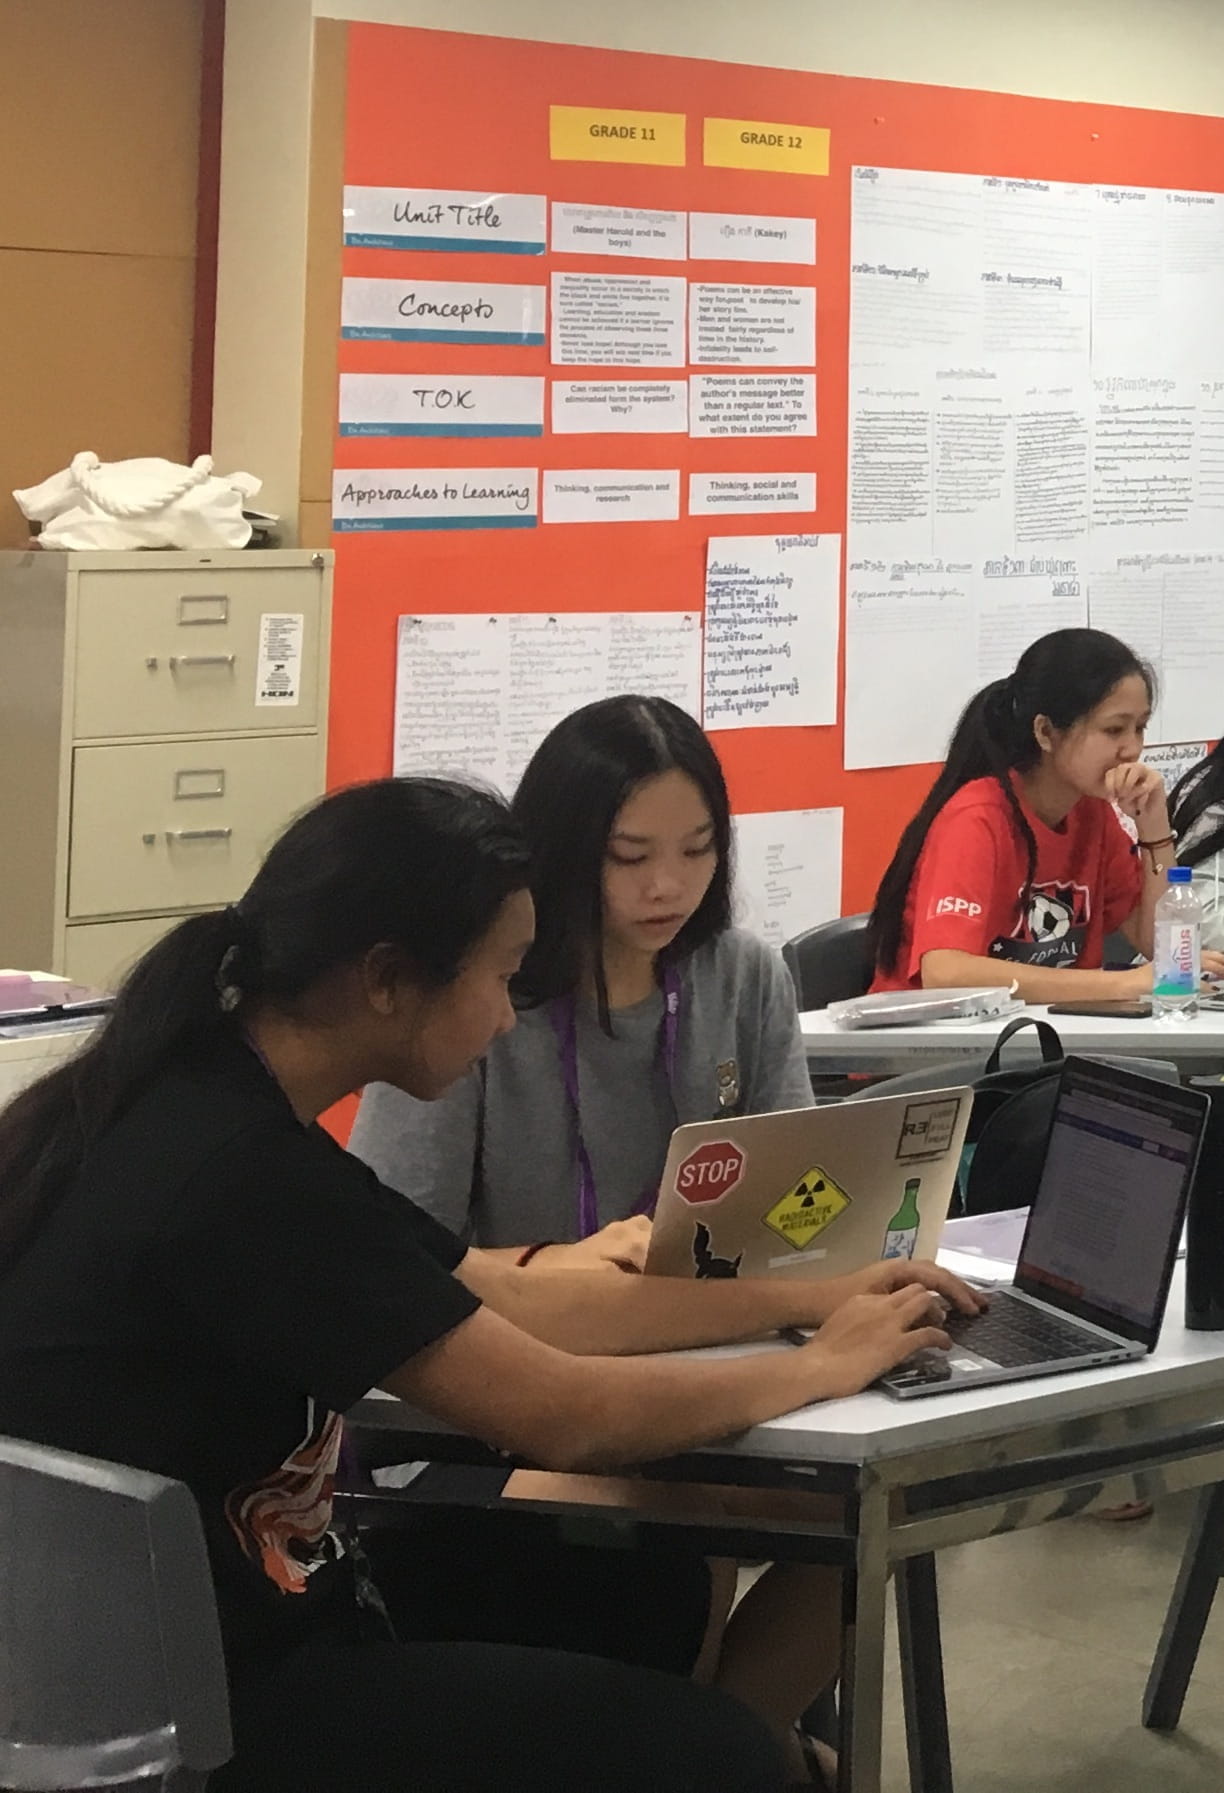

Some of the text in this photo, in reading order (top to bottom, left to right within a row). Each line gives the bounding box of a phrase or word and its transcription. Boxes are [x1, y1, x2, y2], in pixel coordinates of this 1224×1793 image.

[590, 124, 655, 140] GRADE 11
[740, 132, 802, 149] GRADE 12
[393, 201, 501, 227] Unit Title
[607, 228, 634, 236] Harold
[636, 229, 651, 237] and
[754, 228, 787, 240] (Kakey)
[608, 239, 631, 248] boys)
[398, 293, 493, 322] Concepts
[702, 377, 736, 385] "Poems
[757, 378, 788, 387] convey
[790, 377, 804, 385] the
[629, 385, 670, 393] completely
[701, 389, 805, 399] author's message better
[611, 406, 632, 414] Why?
[704, 402, 724, 410] than
[734, 401, 764, 411] regular
[792, 400, 802, 408] To
[699, 413, 807, 423] what extent do you agree
[710, 424, 797, 433] with this statement?
[593, 483, 653, 492] communication
[710, 480, 797, 491] Thinking, social and
[340, 483, 530, 511] Approaches to Learning
[706, 492, 799, 502] communication skills
[936, 896, 982, 916] ISPP
[680, 1158, 739, 1187] STOP
